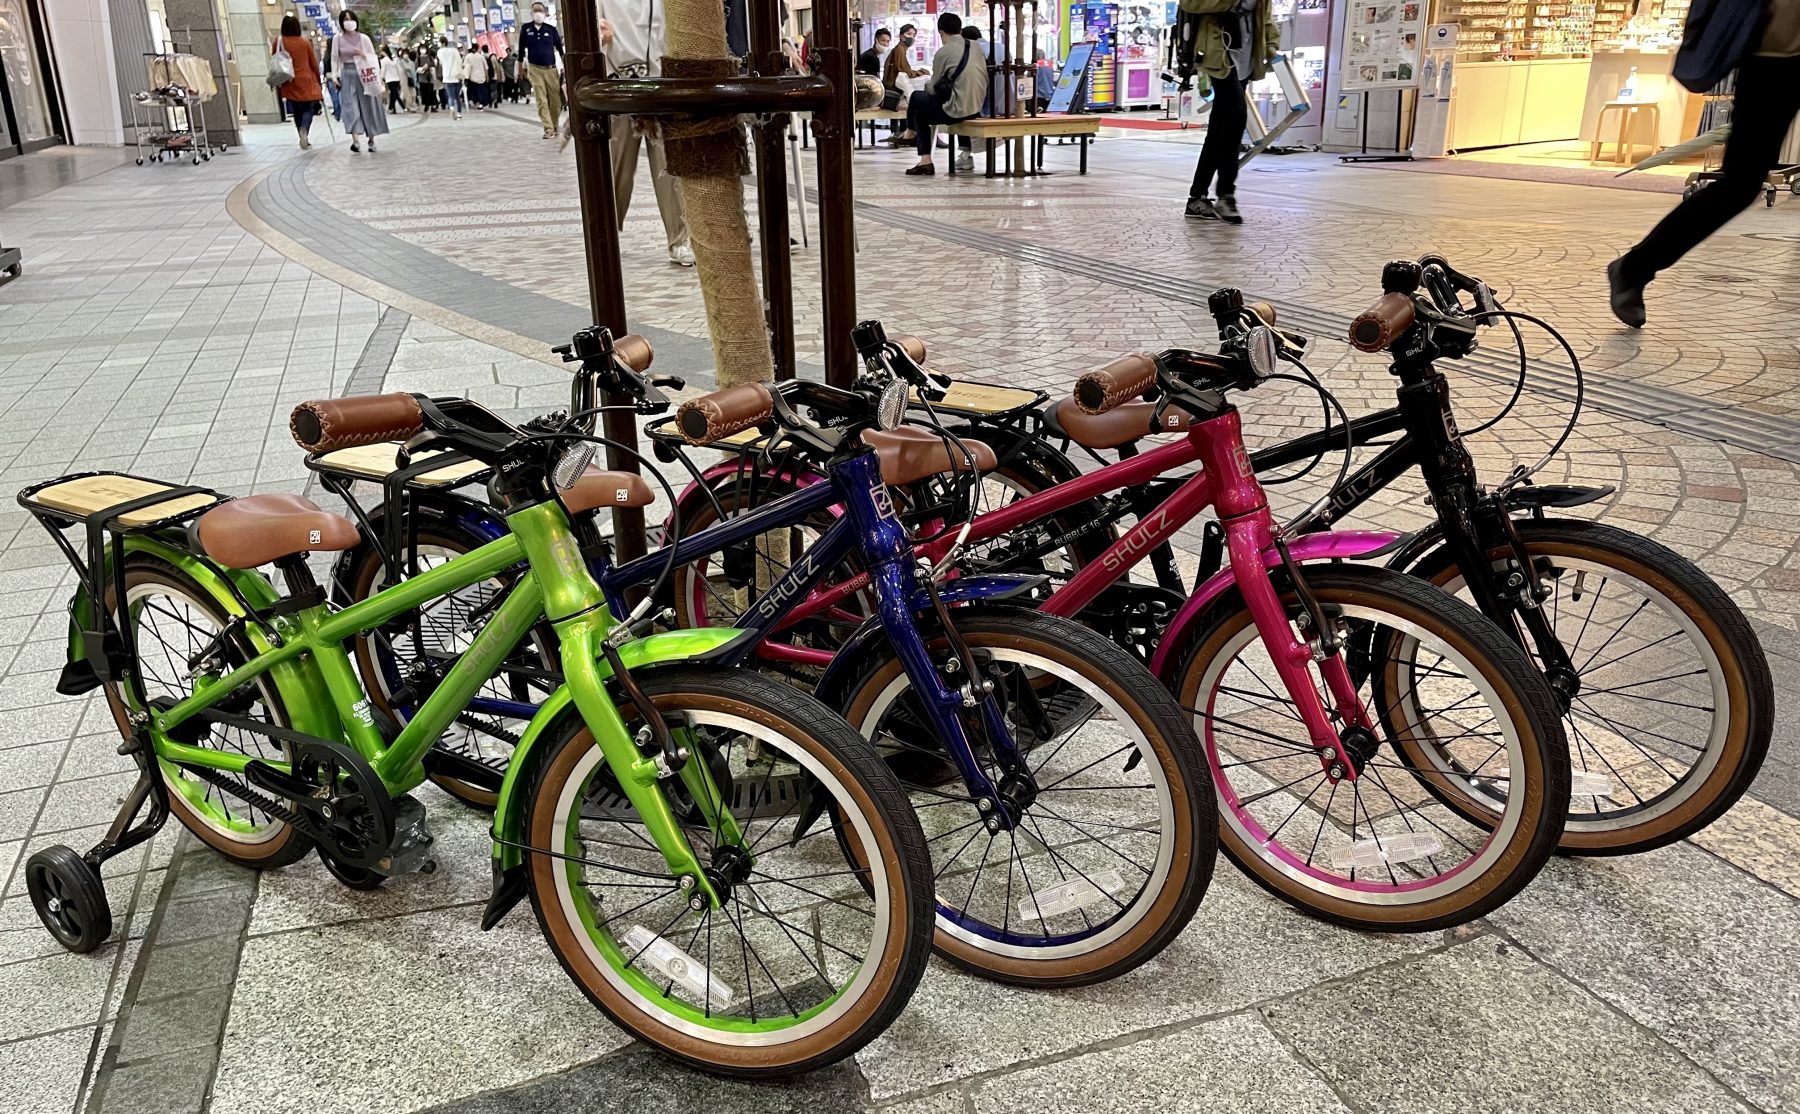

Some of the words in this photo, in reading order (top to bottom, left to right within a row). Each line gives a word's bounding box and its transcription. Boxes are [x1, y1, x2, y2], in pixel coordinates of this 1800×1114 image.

[361, 67, 376, 78] ABC
[1054, 522, 1090, 547] BUBBLE
[1089, 518, 1101, 529] 16
[1102, 508, 1175, 572] SHULZ
[759, 553, 821, 619] SHULZ
[461, 611, 513, 676] SHULZ
